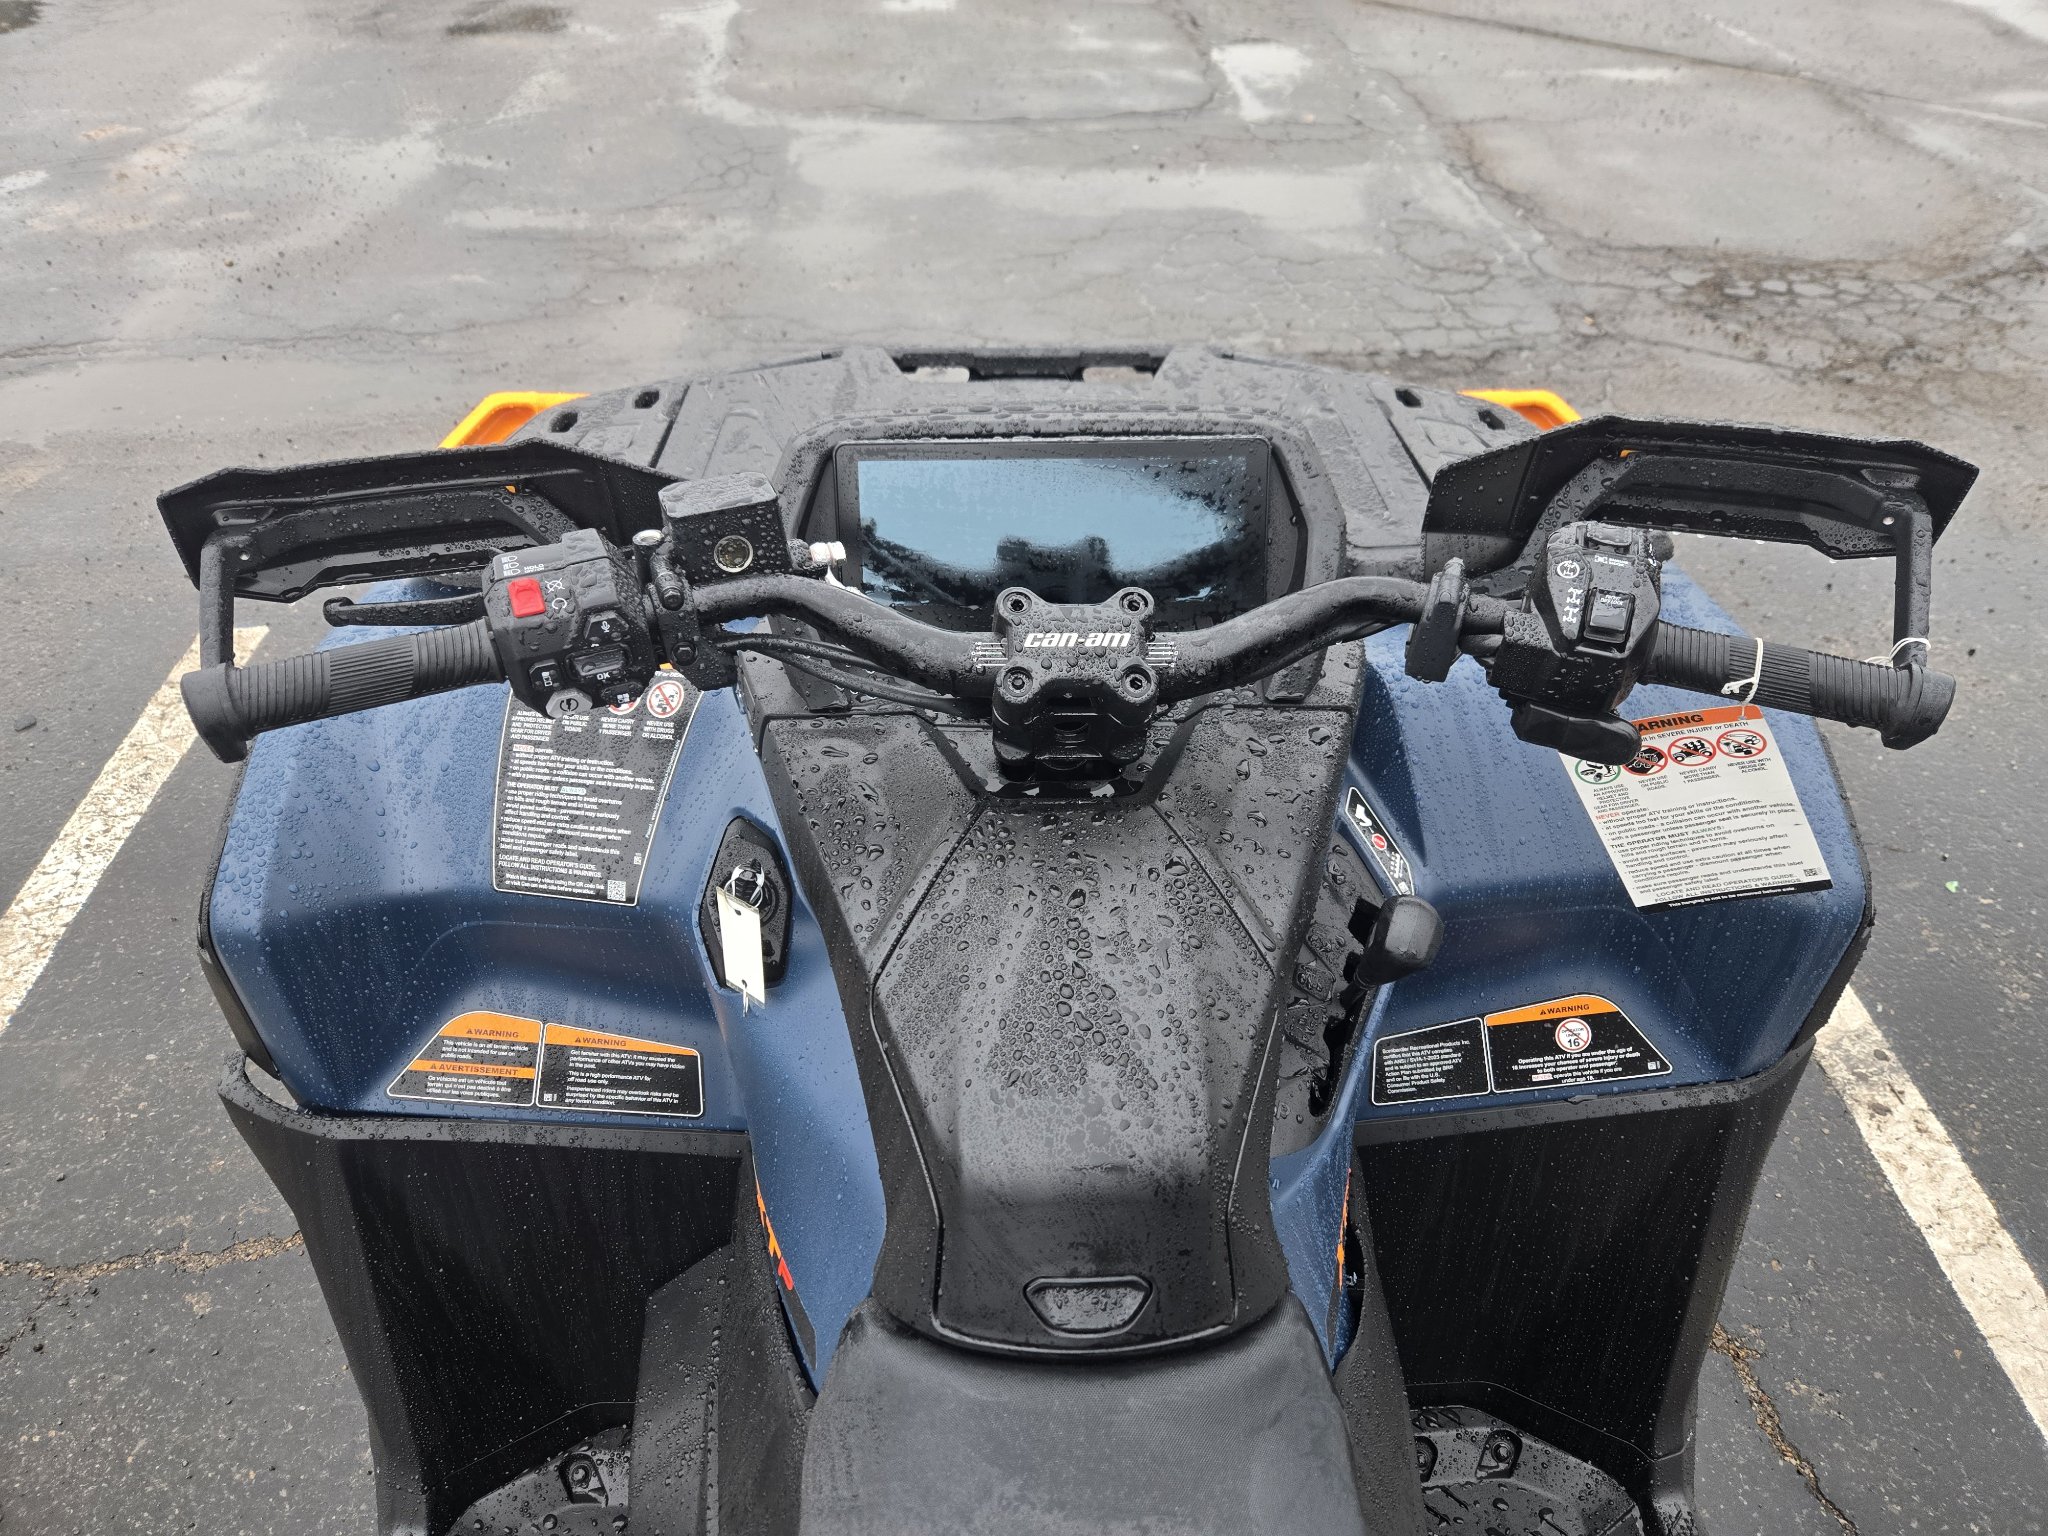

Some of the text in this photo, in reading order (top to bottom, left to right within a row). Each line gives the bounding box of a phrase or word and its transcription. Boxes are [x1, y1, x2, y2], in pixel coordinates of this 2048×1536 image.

[1024, 632, 1132, 648] can-am
[596, 671, 610, 680] OK
[1638, 714, 1704, 732] ARNING
[1658, 731, 1686, 739] SEVERE
[1687, 726, 1712, 734] INJURY
[1601, 816, 1625, 824] without
[1661, 805, 1687, 814] training
[1695, 796, 1737, 807] instructions.
[1611, 821, 1635, 829] speeds
[1725, 798, 1762, 808] conditions.
[1620, 806, 1649, 816] operate:
[1664, 816, 1692, 825] collision
[1629, 829, 1661, 838] passenger
[1683, 819, 1717, 828] passenger
[1625, 835, 1667, 845] OPERATOR
[1547, 1004, 1590, 1015] WARNING
[475, 1028, 519, 1038] WARNING
[583, 1037, 627, 1047] WARNING
[1568, 1038, 1580, 1047] 16
[439, 1063, 518, 1076] AVERTISSEMENT
